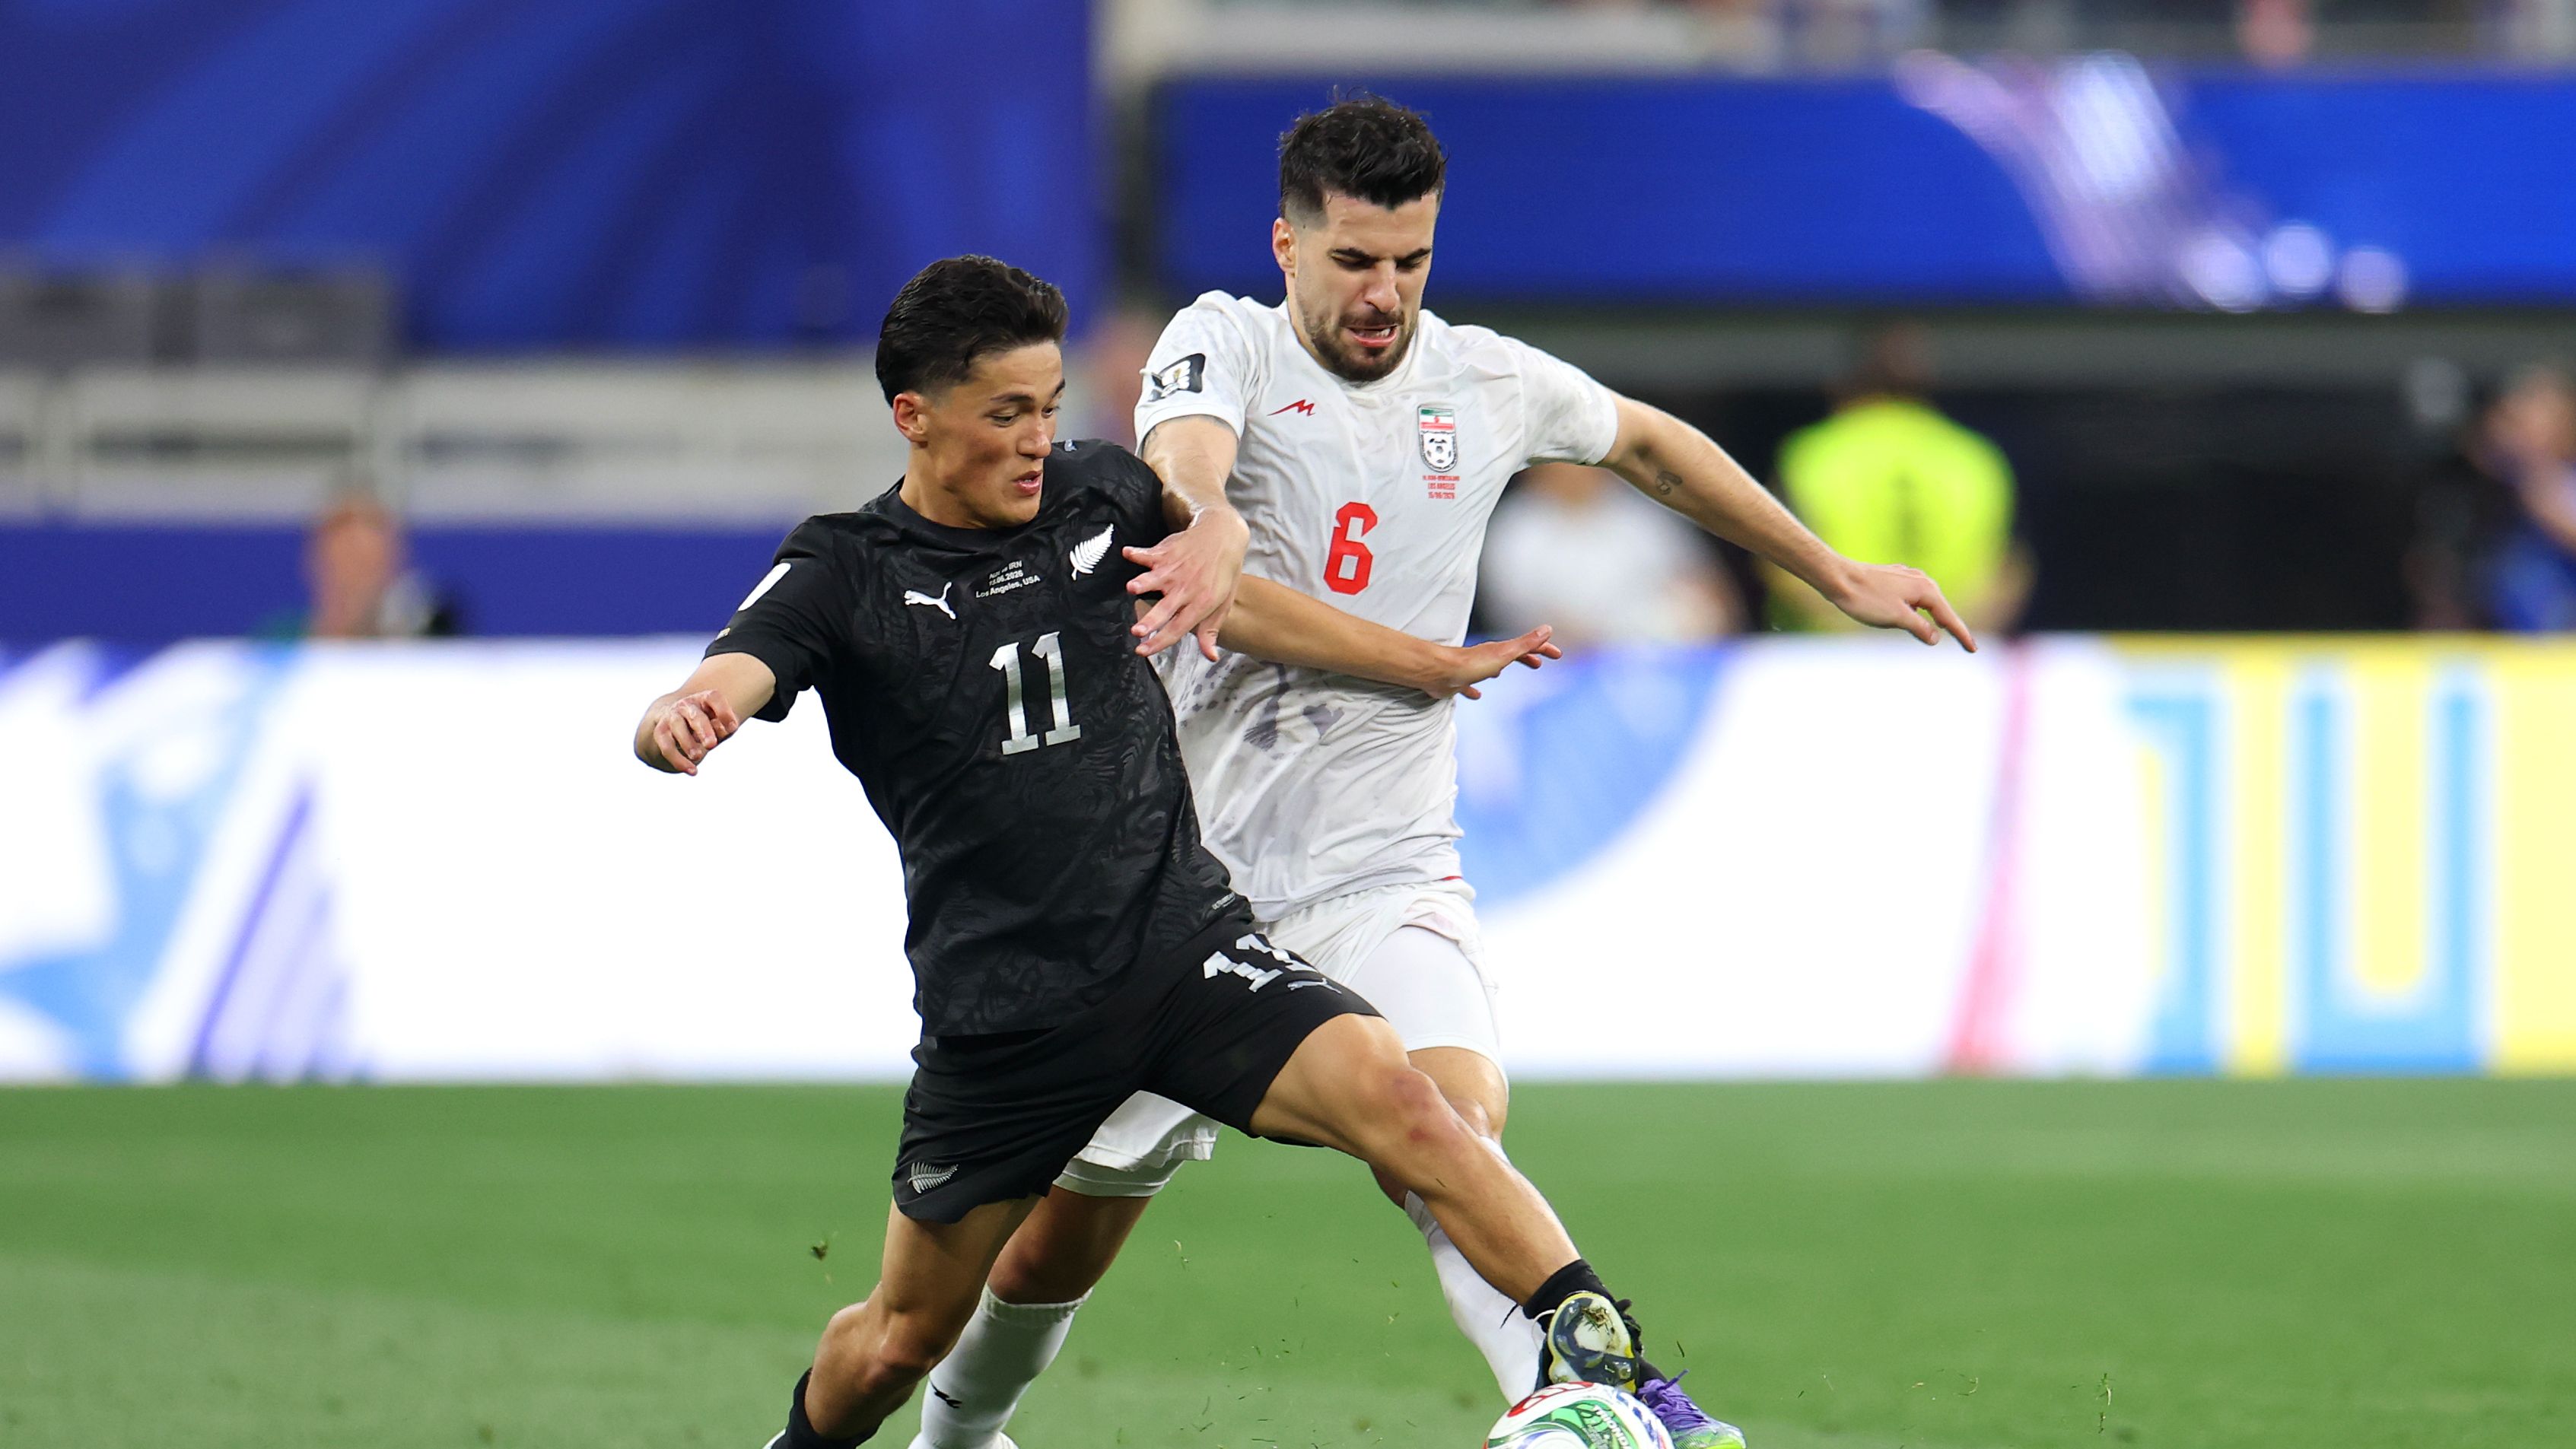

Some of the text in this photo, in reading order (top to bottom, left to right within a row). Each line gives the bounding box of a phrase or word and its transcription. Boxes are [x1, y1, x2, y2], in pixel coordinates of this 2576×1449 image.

[1008, 560, 1022, 570] IRN
[1323, 501, 1378, 596] 6
[975, 574, 1042, 599] Los Angeles, USA
[989, 631, 1081, 755] 11
